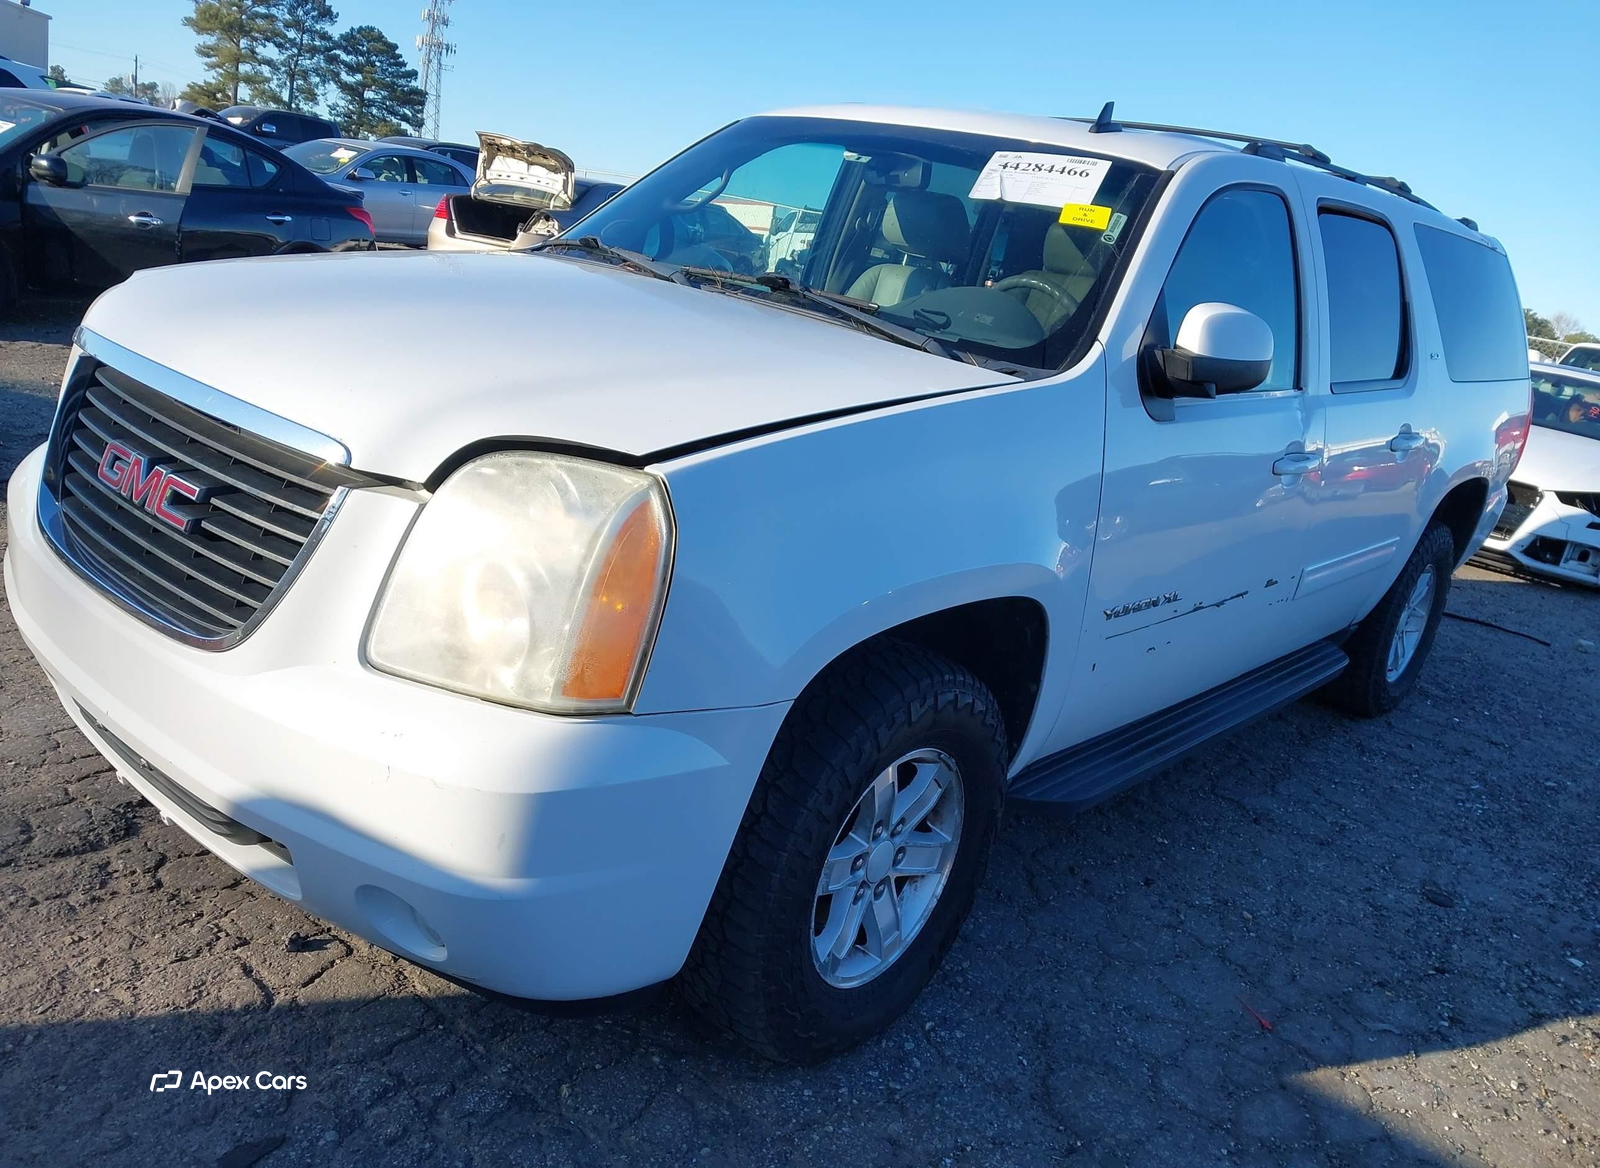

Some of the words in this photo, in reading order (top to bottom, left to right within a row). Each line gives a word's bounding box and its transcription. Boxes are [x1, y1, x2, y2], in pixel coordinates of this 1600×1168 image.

[998, 161, 1092, 179] 44284466
[1072, 216, 1096, 224] DRIVE
[98, 440, 201, 533] GMC
[1161, 590, 1183, 606] XL
